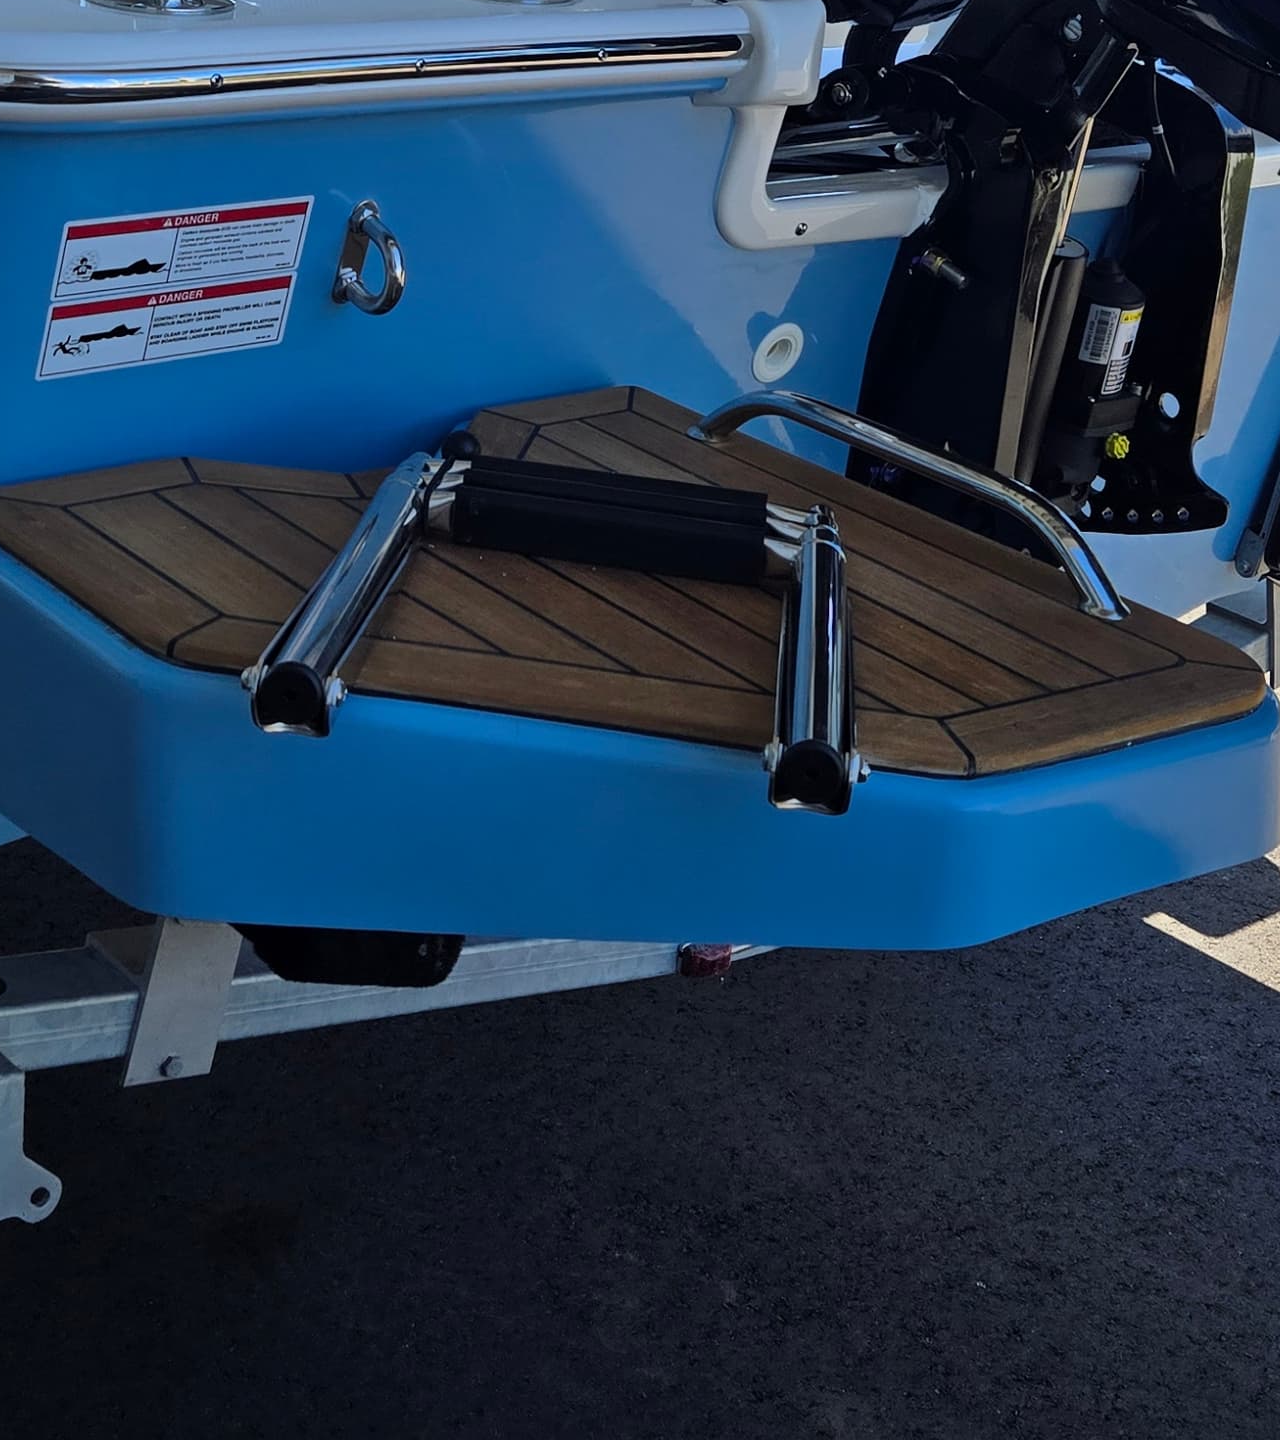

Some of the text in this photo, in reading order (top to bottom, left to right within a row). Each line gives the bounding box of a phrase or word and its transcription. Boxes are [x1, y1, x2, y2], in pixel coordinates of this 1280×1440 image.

[174, 214, 220, 227] DANGER
[159, 290, 204, 305] DANGER
[154, 314, 178, 322] CONTACT
[222, 304, 251, 312] PROPELLER
[253, 317, 279, 325] PLATFORM
[161, 336, 188, 344] BOARDING
